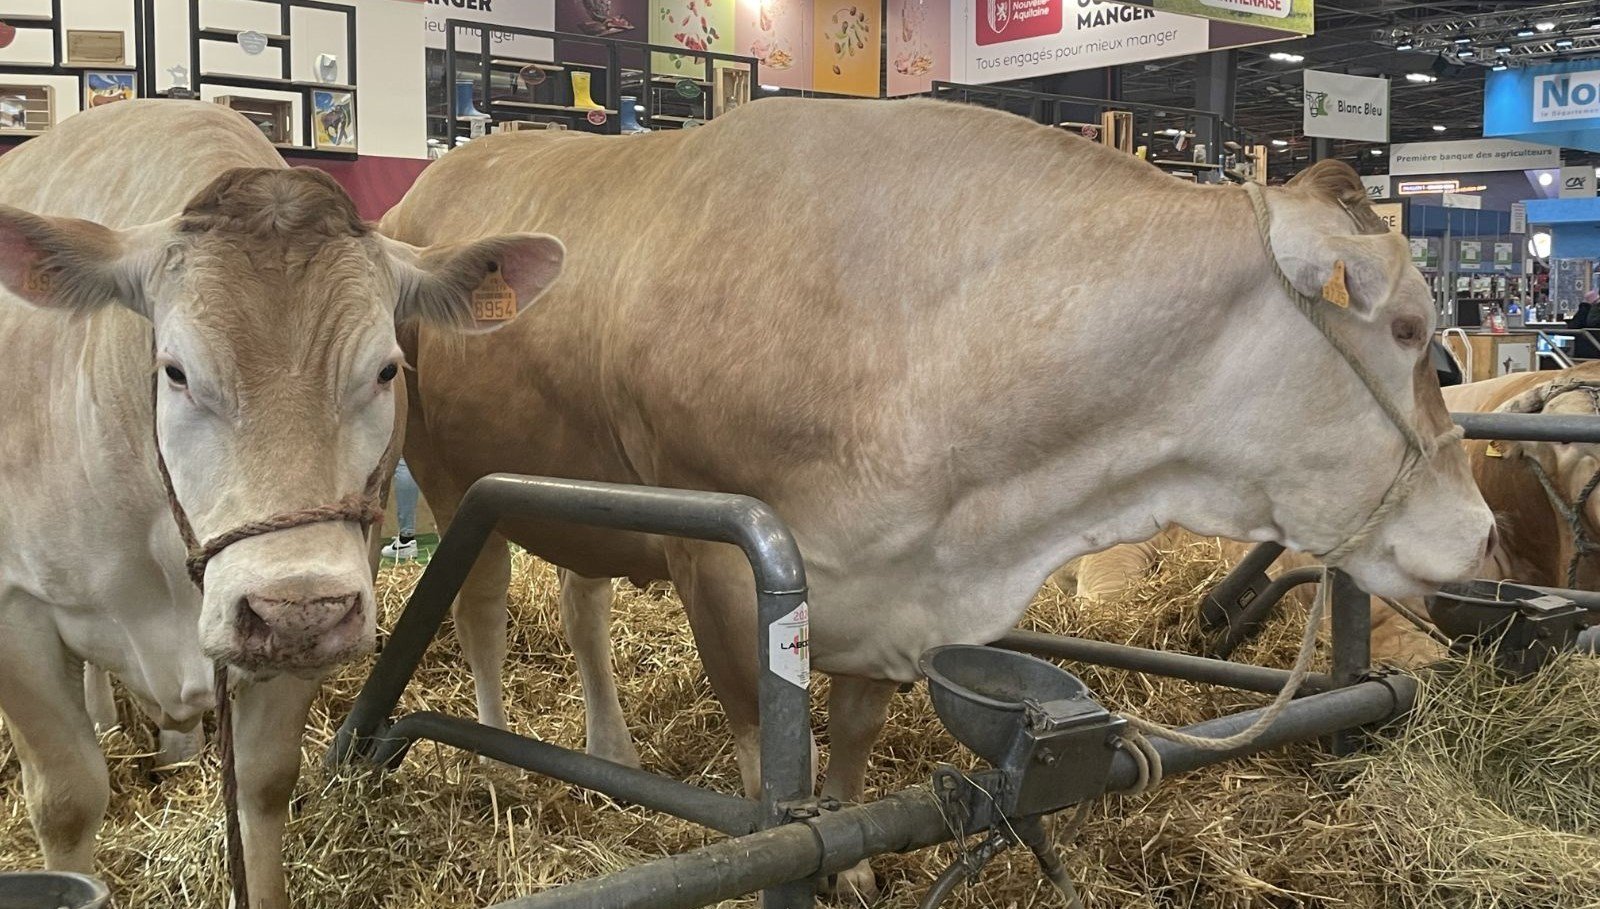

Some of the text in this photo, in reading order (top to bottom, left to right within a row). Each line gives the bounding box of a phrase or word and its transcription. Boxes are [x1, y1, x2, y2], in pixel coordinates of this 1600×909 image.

[1013, 7, 1050, 22] Aquitaine
[1077, 5, 1156, 30] MANGER
[976, 29, 1177, 70] Tous engagés pour mieux manger
[1542, 78, 1600, 108] No
[1337, 100, 1383, 116] Blanc Bleu
[1396, 148, 1553, 163] Première banque des agriculteurs
[474, 300, 513, 318] 8954
